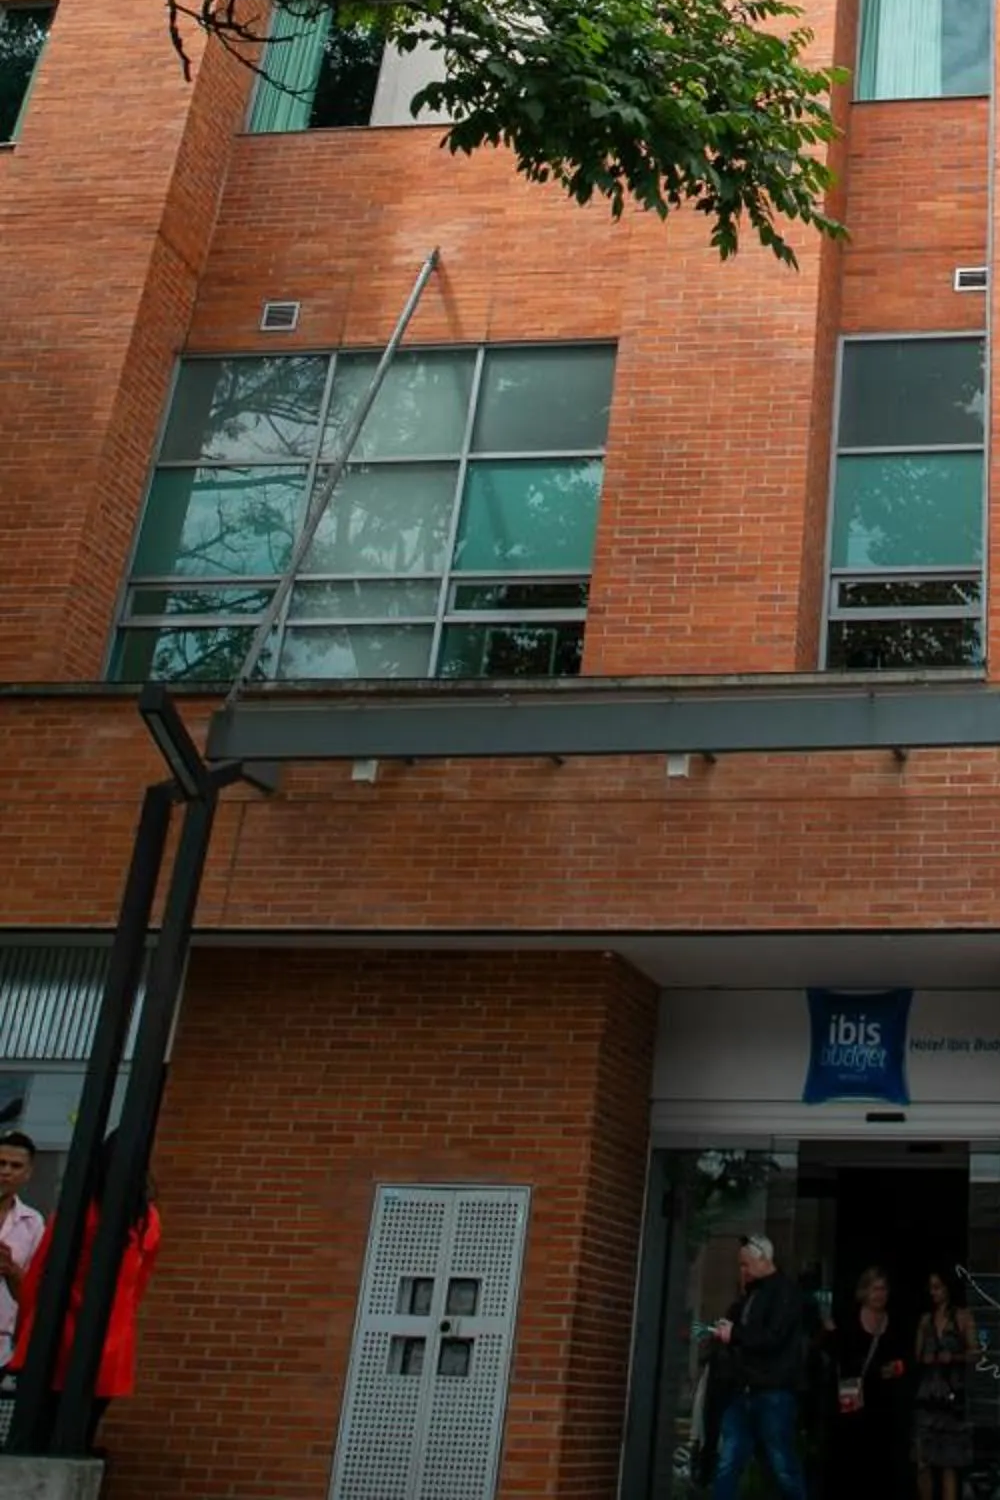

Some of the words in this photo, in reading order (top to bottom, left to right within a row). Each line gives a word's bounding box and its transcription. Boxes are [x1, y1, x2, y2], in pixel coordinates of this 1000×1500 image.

[829, 1014, 881, 1046] ibis
[910, 1037, 945, 1051] Hotel
[820, 1043, 888, 1072] budget
